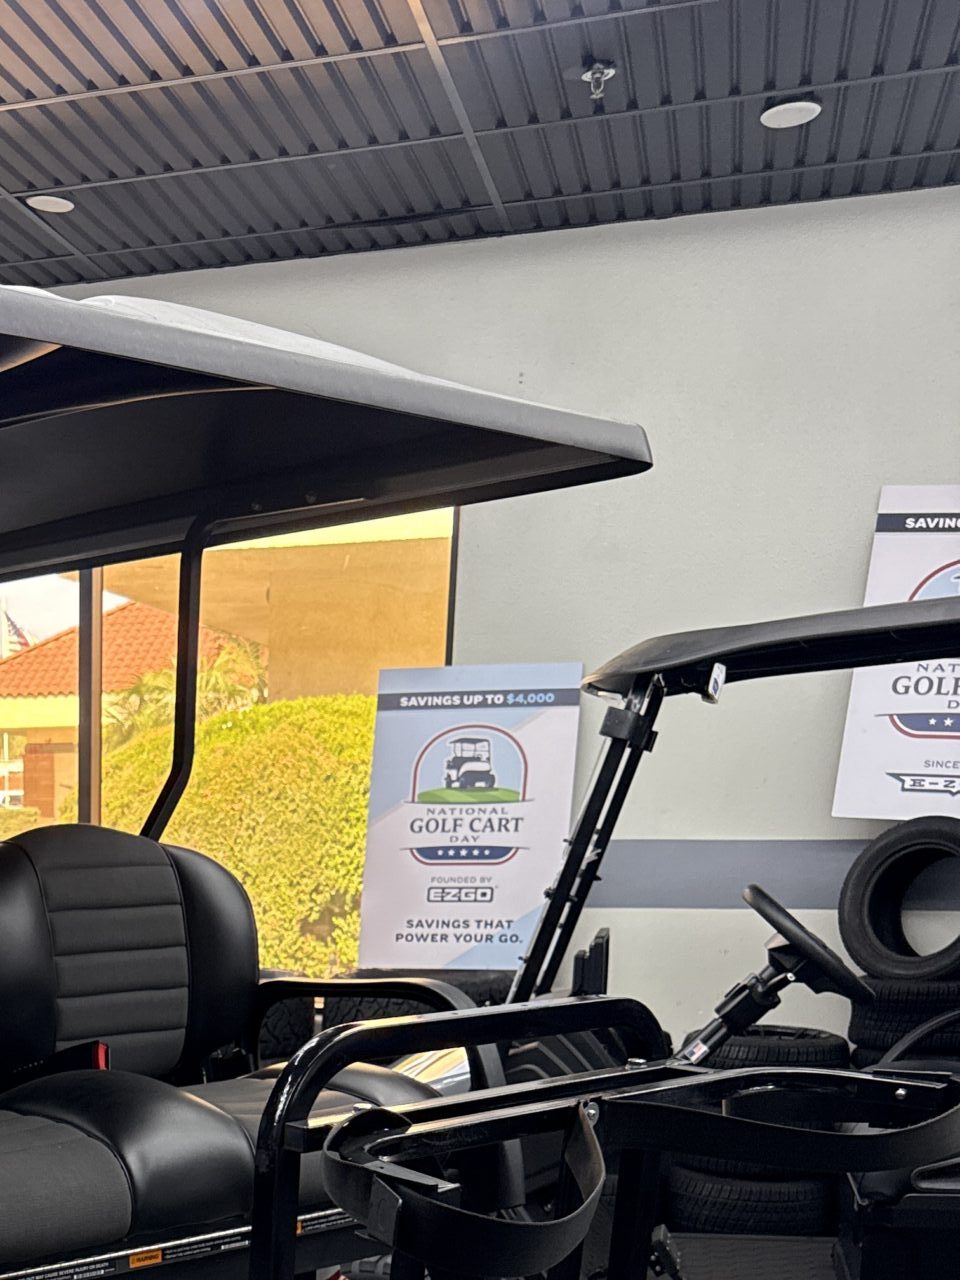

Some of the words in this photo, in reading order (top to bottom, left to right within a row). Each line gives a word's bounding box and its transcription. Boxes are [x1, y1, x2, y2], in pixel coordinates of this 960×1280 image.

[905, 517, 960, 529] SAVIN
[400, 694, 461, 707] SAVINGS
[463, 694, 483, 705] UP
[485, 693, 505, 705] TO
[506, 692, 555, 706] $4,000
[923, 759, 960, 769] SINCE
[426, 807, 509, 816] NATIONAL
[409, 817, 464, 834] GOLF
[469, 817, 524, 833] CART
[449, 835, 481, 843] DAY
[430, 876, 477, 884] FOUNDED
[479, 876, 493, 884] BY
[406, 919, 470, 929] SAVINGS
[475, 919, 514, 929] THAT
[395, 933, 449, 943] POWER
[453, 933, 494, 943] YOUR
[498, 933, 524, 944] GO.
